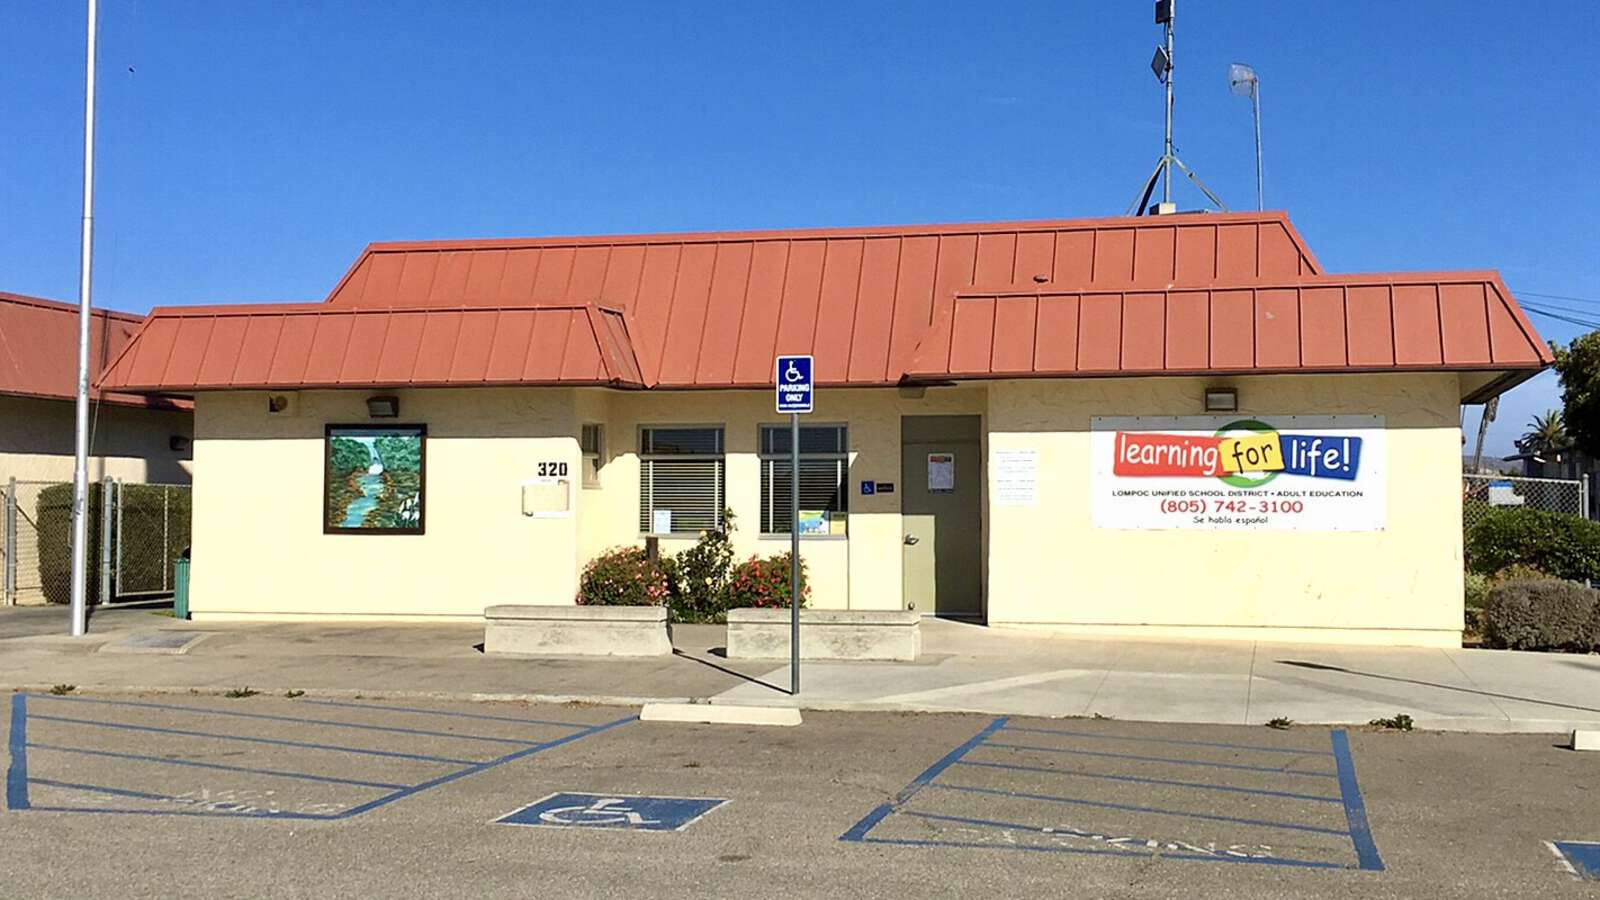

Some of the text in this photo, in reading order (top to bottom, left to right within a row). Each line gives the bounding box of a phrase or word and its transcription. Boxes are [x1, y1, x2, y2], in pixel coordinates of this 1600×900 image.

[779, 383, 810, 392] PARKING
[785, 393, 804, 402] ONLY
[1119, 434, 1350, 476] learning for life!
[537, 462, 568, 477] 320
[1160, 499, 1303, 514] (805) 742-3100
[1193, 516, 1268, 525] Se habla español
